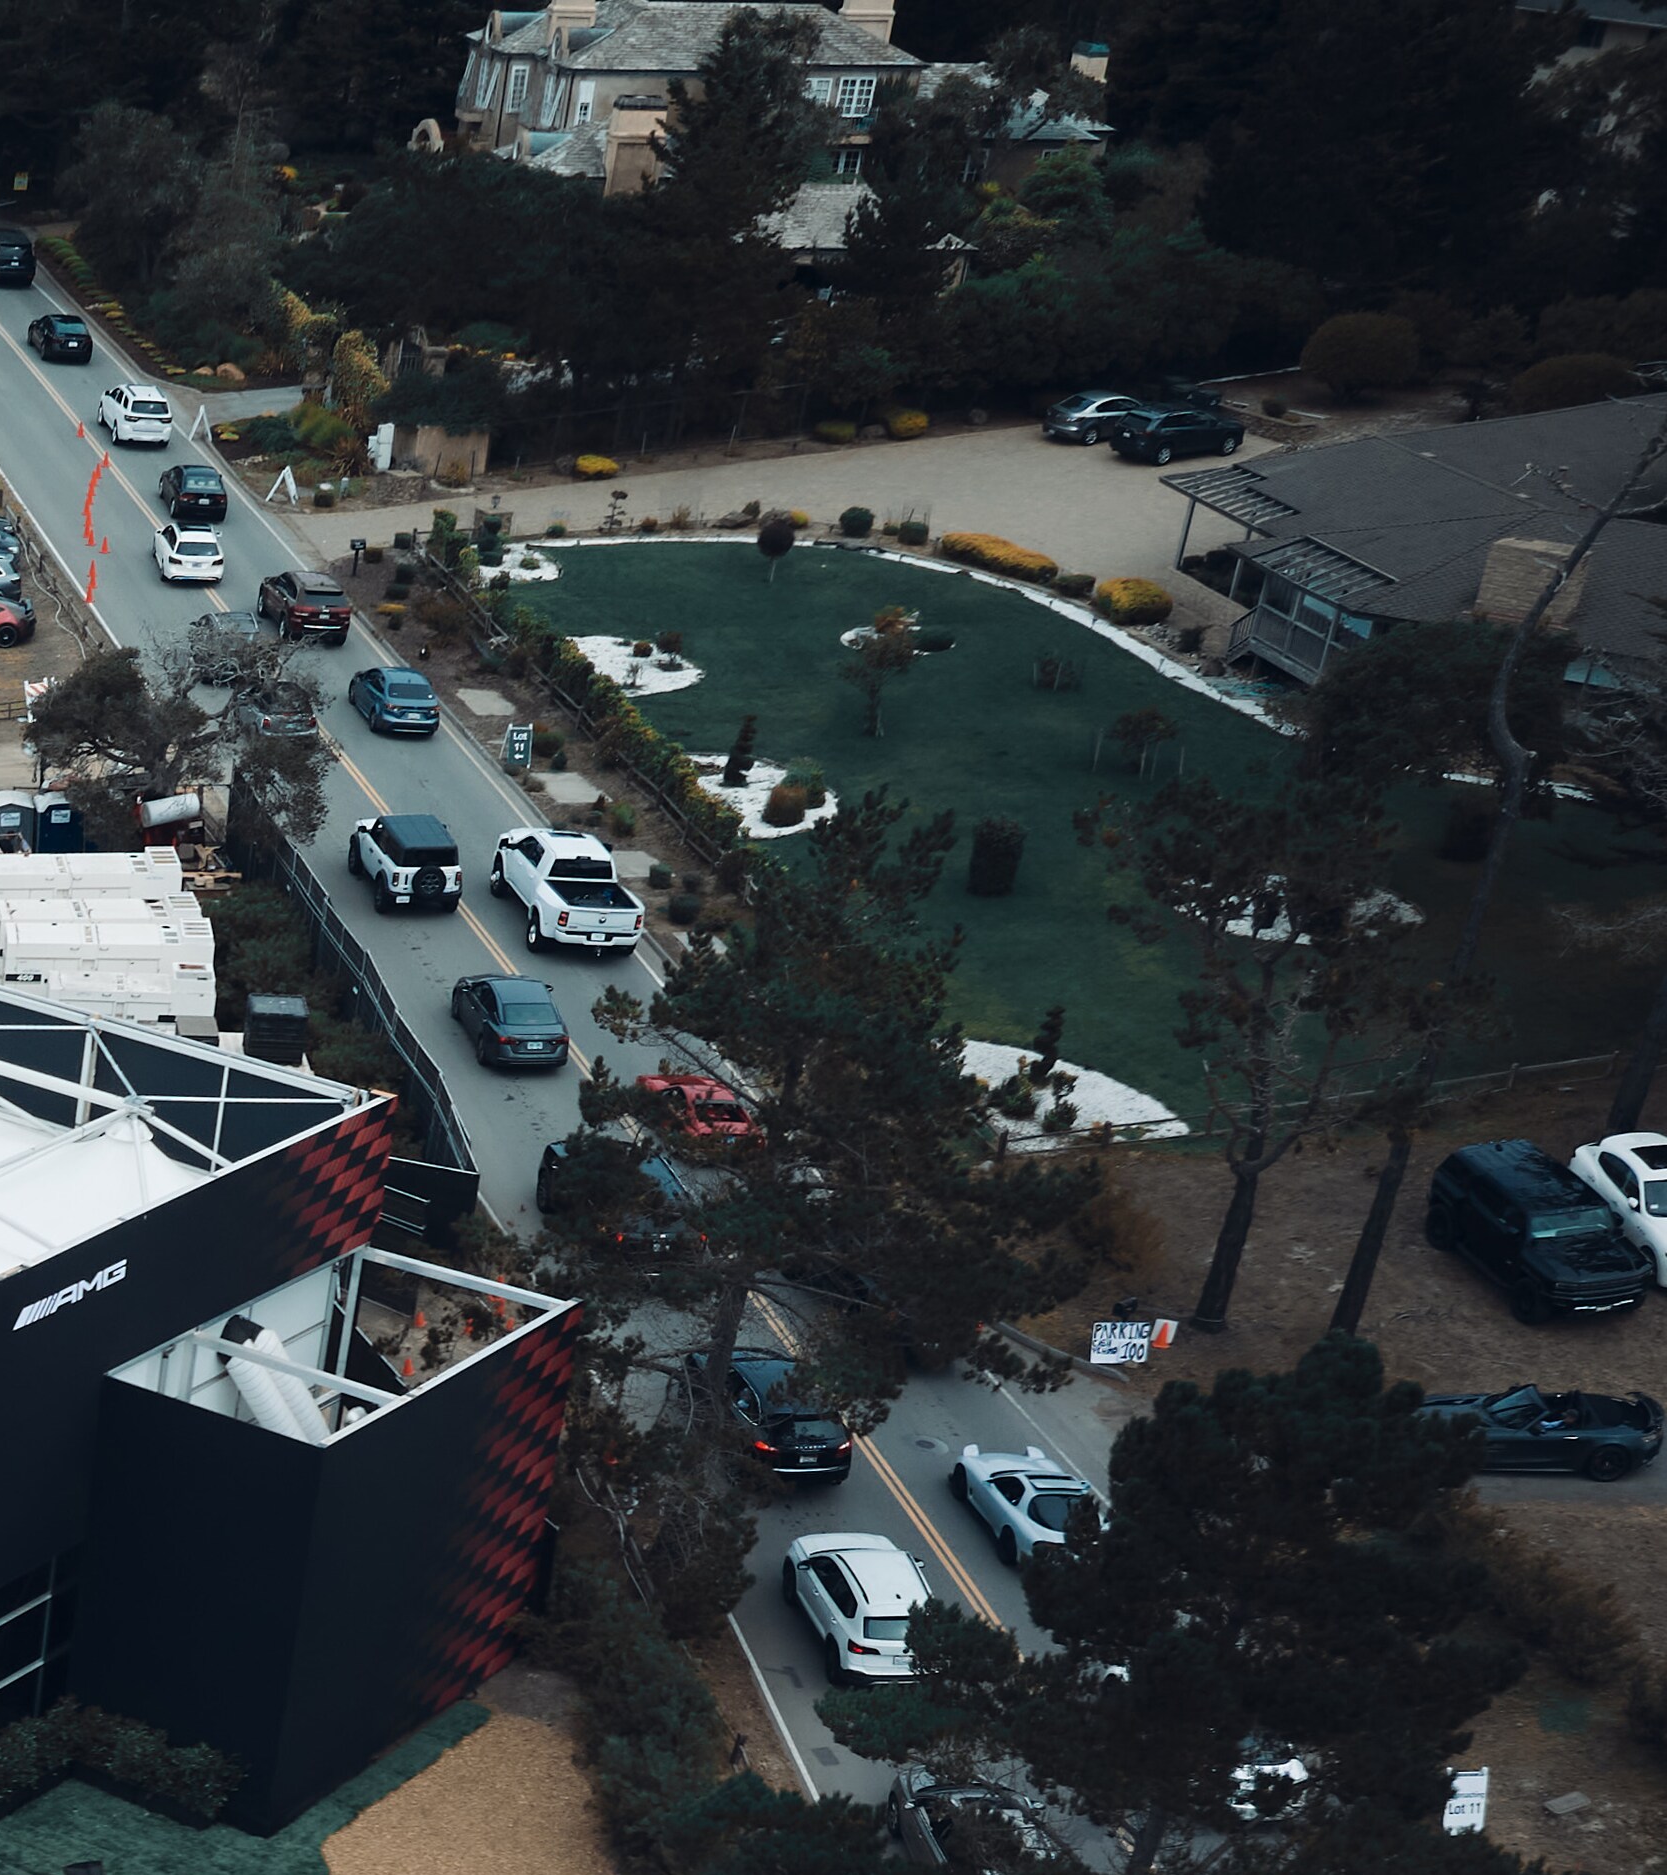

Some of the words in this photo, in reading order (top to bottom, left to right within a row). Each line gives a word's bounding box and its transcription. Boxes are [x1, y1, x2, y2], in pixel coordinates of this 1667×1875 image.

[49, 1258, 128, 1314] AMG
[1092, 1322, 1151, 1340] PARKING
[1448, 1803, 1465, 1815] Lot
[1470, 1802, 1481, 1815] 11
